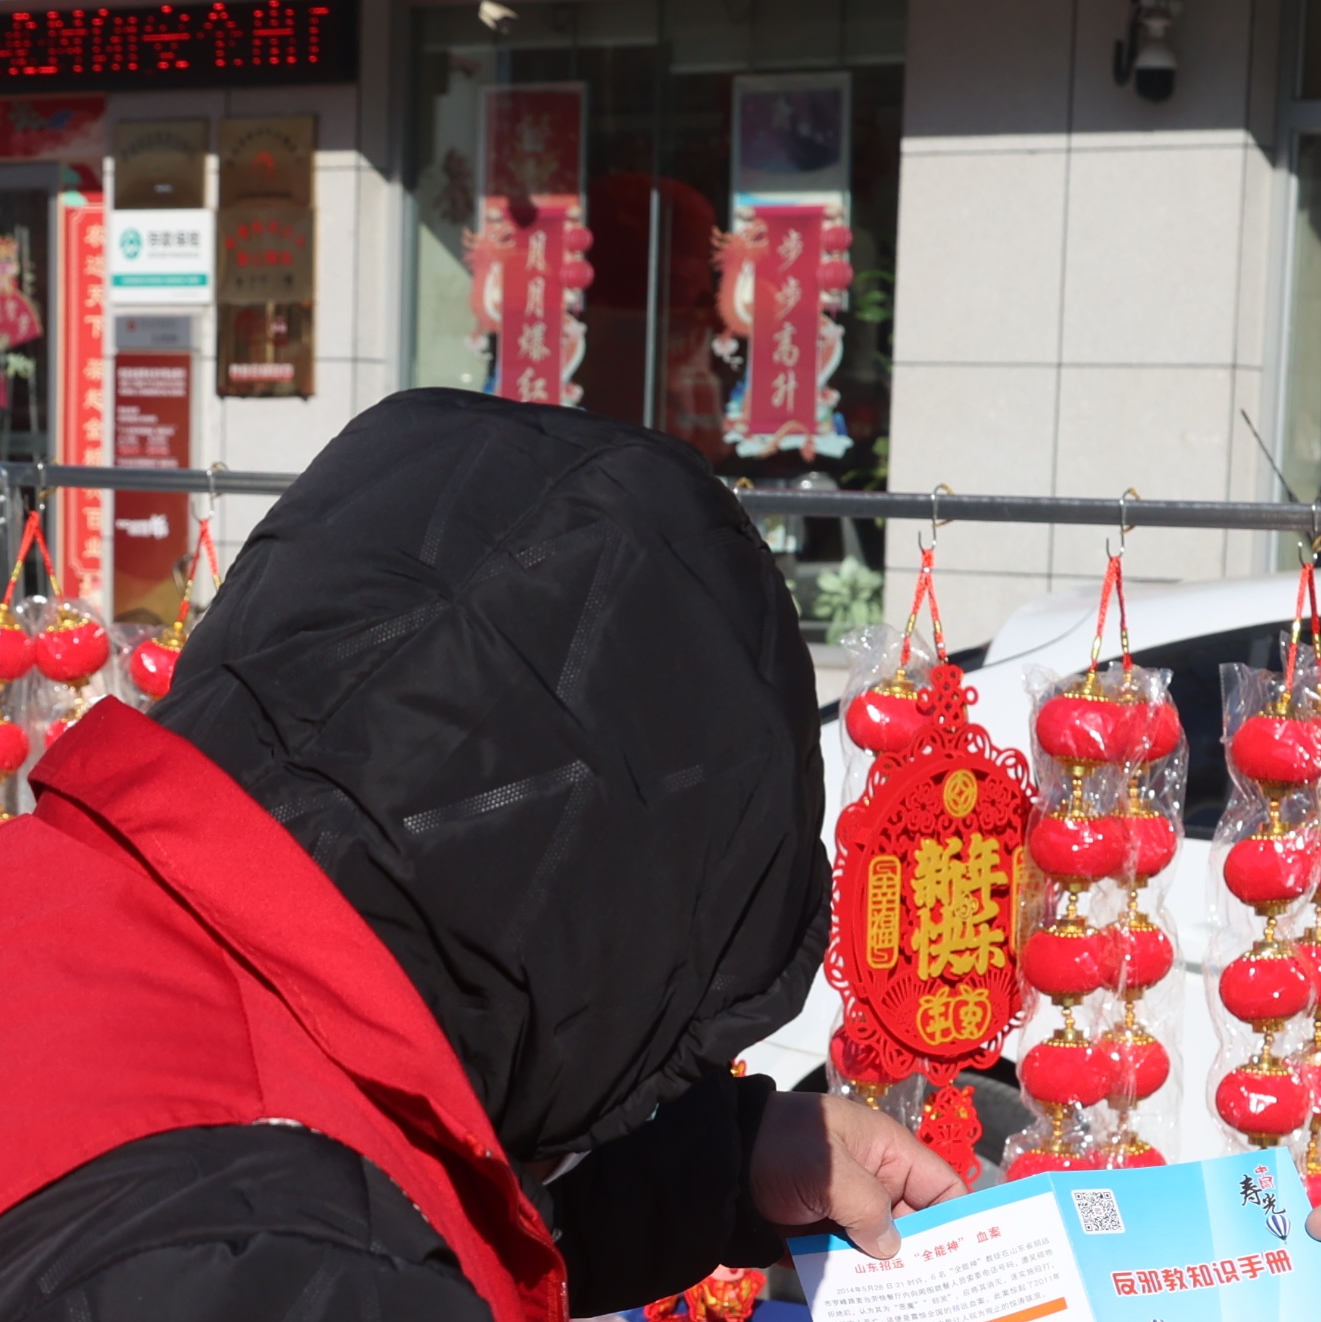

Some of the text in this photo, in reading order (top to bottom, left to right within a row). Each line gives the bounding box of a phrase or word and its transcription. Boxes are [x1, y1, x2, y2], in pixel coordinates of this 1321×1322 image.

[771, 227, 804, 413] 步步高升
[1239, 1174, 1286, 1215] 寿光
[1254, 1165, 1275, 1190] 中国
[1112, 1249, 1293, 1295] 反邪教知识手册
